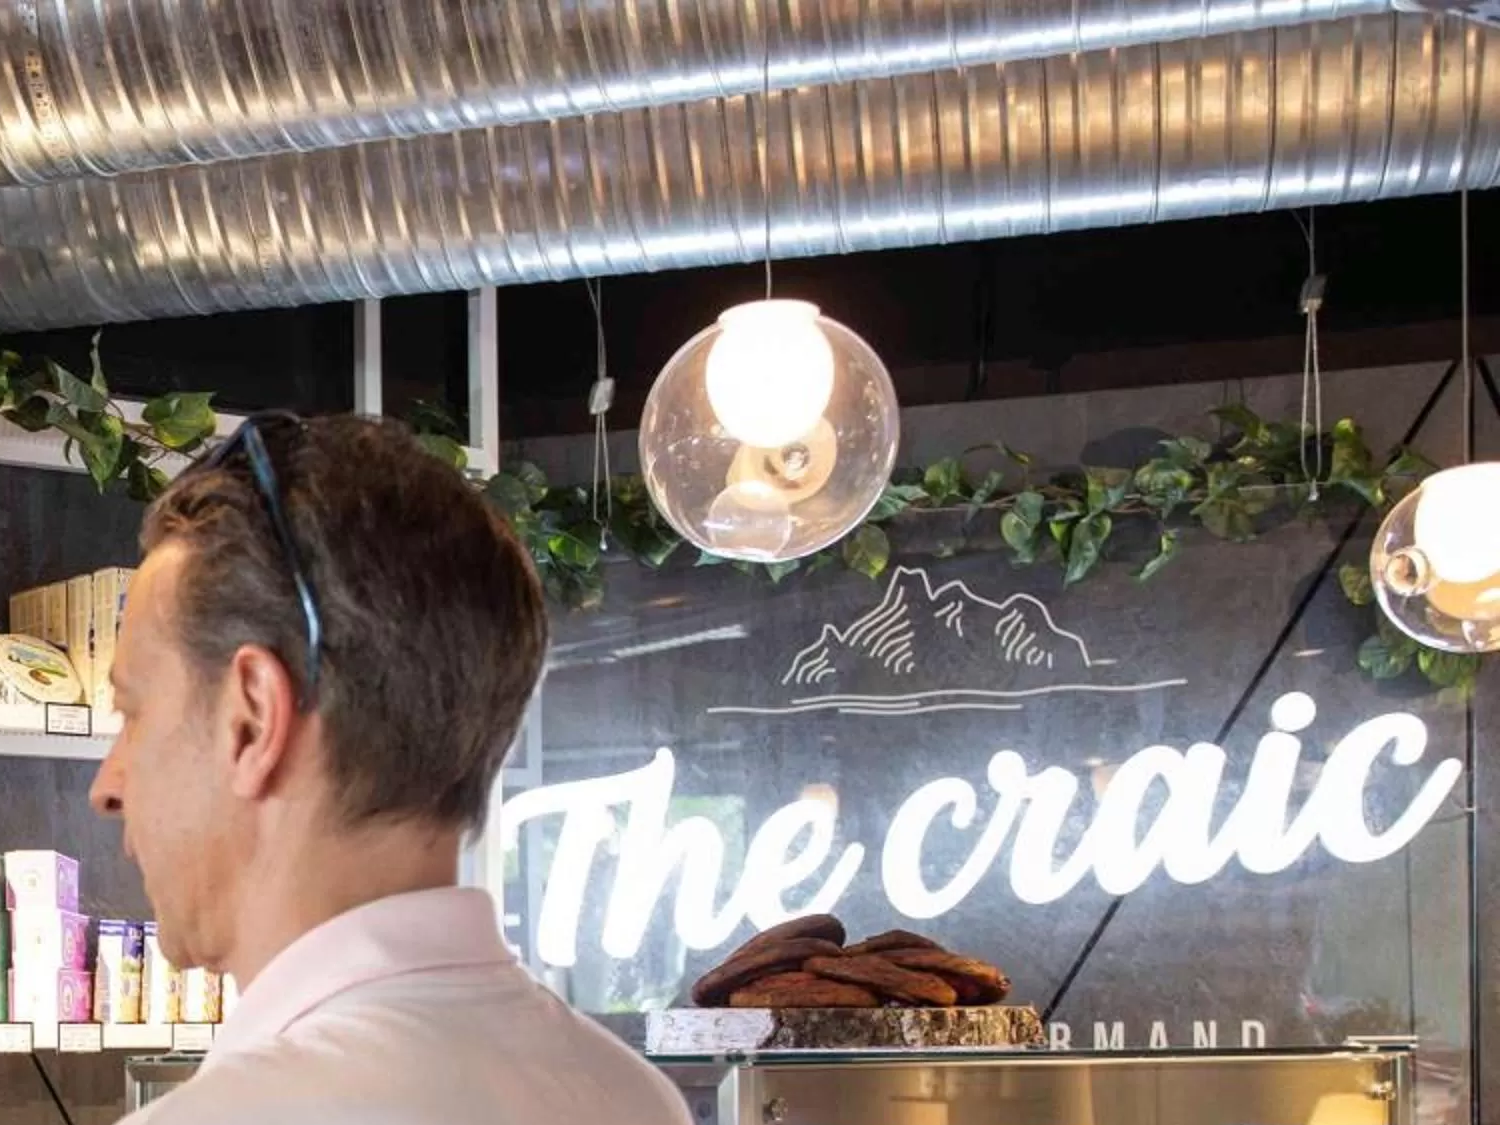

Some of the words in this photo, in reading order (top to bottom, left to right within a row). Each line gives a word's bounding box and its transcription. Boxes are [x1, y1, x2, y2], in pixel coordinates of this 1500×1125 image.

[501, 747, 864, 967] The
[882, 691, 1461, 918] craic
[1050, 1020, 1265, 1050] RMAND
